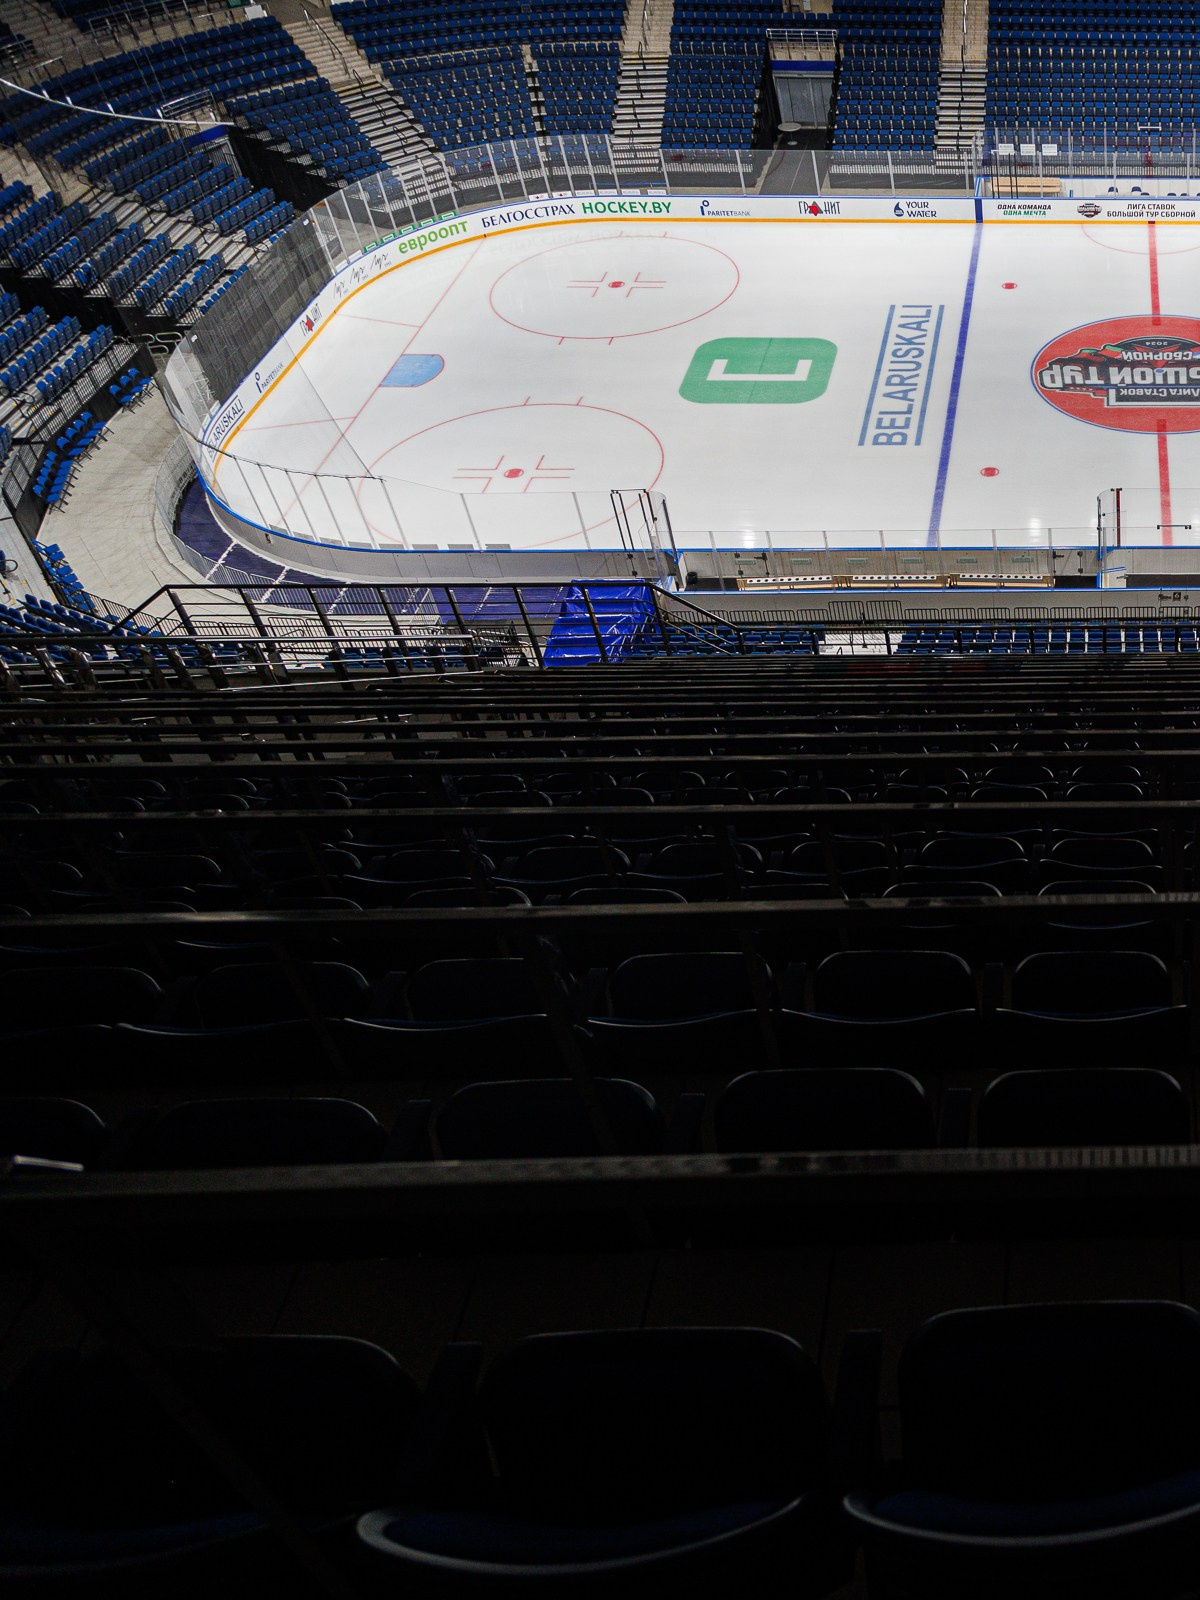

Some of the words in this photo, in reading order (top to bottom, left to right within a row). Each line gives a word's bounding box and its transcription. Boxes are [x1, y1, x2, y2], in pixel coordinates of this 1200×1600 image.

[582, 201, 672, 214] HOCKEY.BY
[906, 201, 929, 209] YOUR
[481, 203, 576, 229] БЕЛГОССТРАХ
[906, 210, 937, 218] WATER
[1107, 210, 1144, 218] БОЛЬШОЙ
[1160, 210, 1196, 218] СБОРНОЙ
[398, 220, 468, 254] евроопт
[1121, 350, 1194, 362] СБОРНОЙ
[871, 304, 933, 446] BELARUSKALI
[1042, 364, 1106, 388] ТУР
